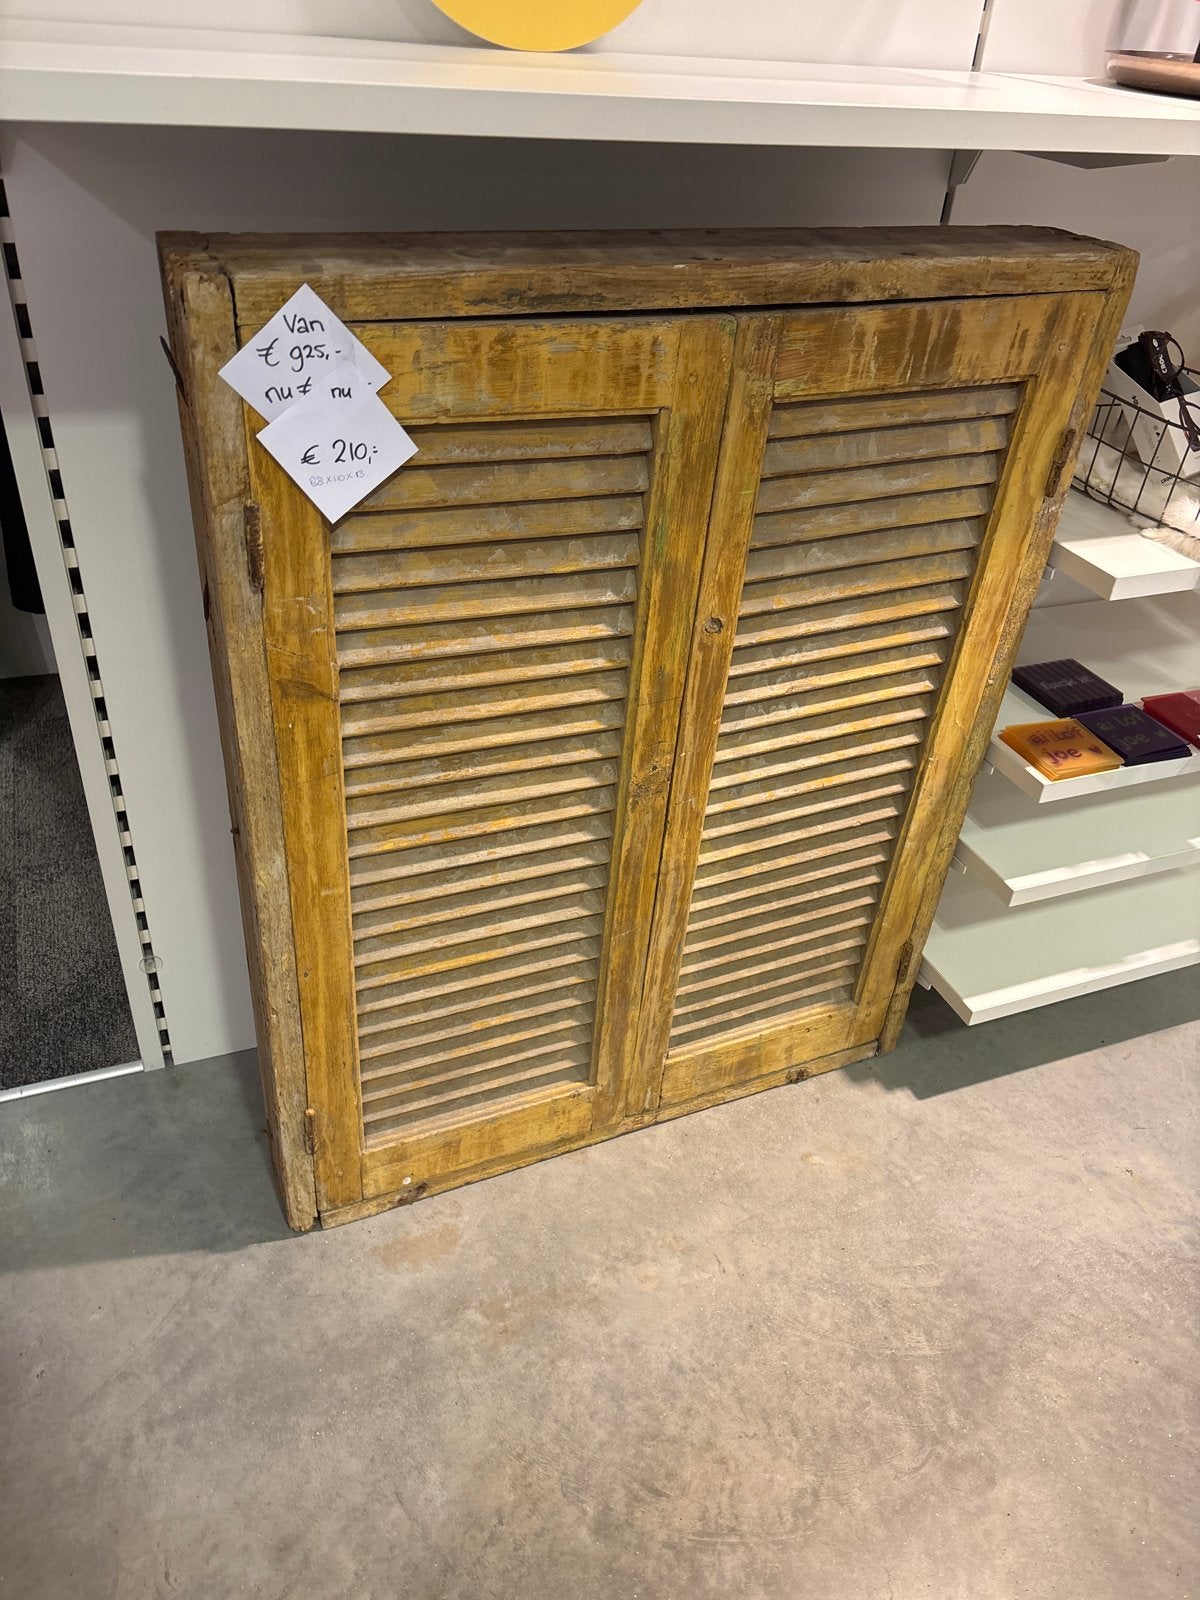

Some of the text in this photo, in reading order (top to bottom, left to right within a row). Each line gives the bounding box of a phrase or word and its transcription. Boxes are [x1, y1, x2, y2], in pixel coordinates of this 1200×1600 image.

[283, 314, 325, 333] Van
[256, 338, 280, 367] €
[265, 387, 293, 403] nu
[331, 386, 352, 399] nu
[300, 444, 321, 465] €
[1112, 733, 1150, 750] joe
[1041, 747, 1082, 765] joe
